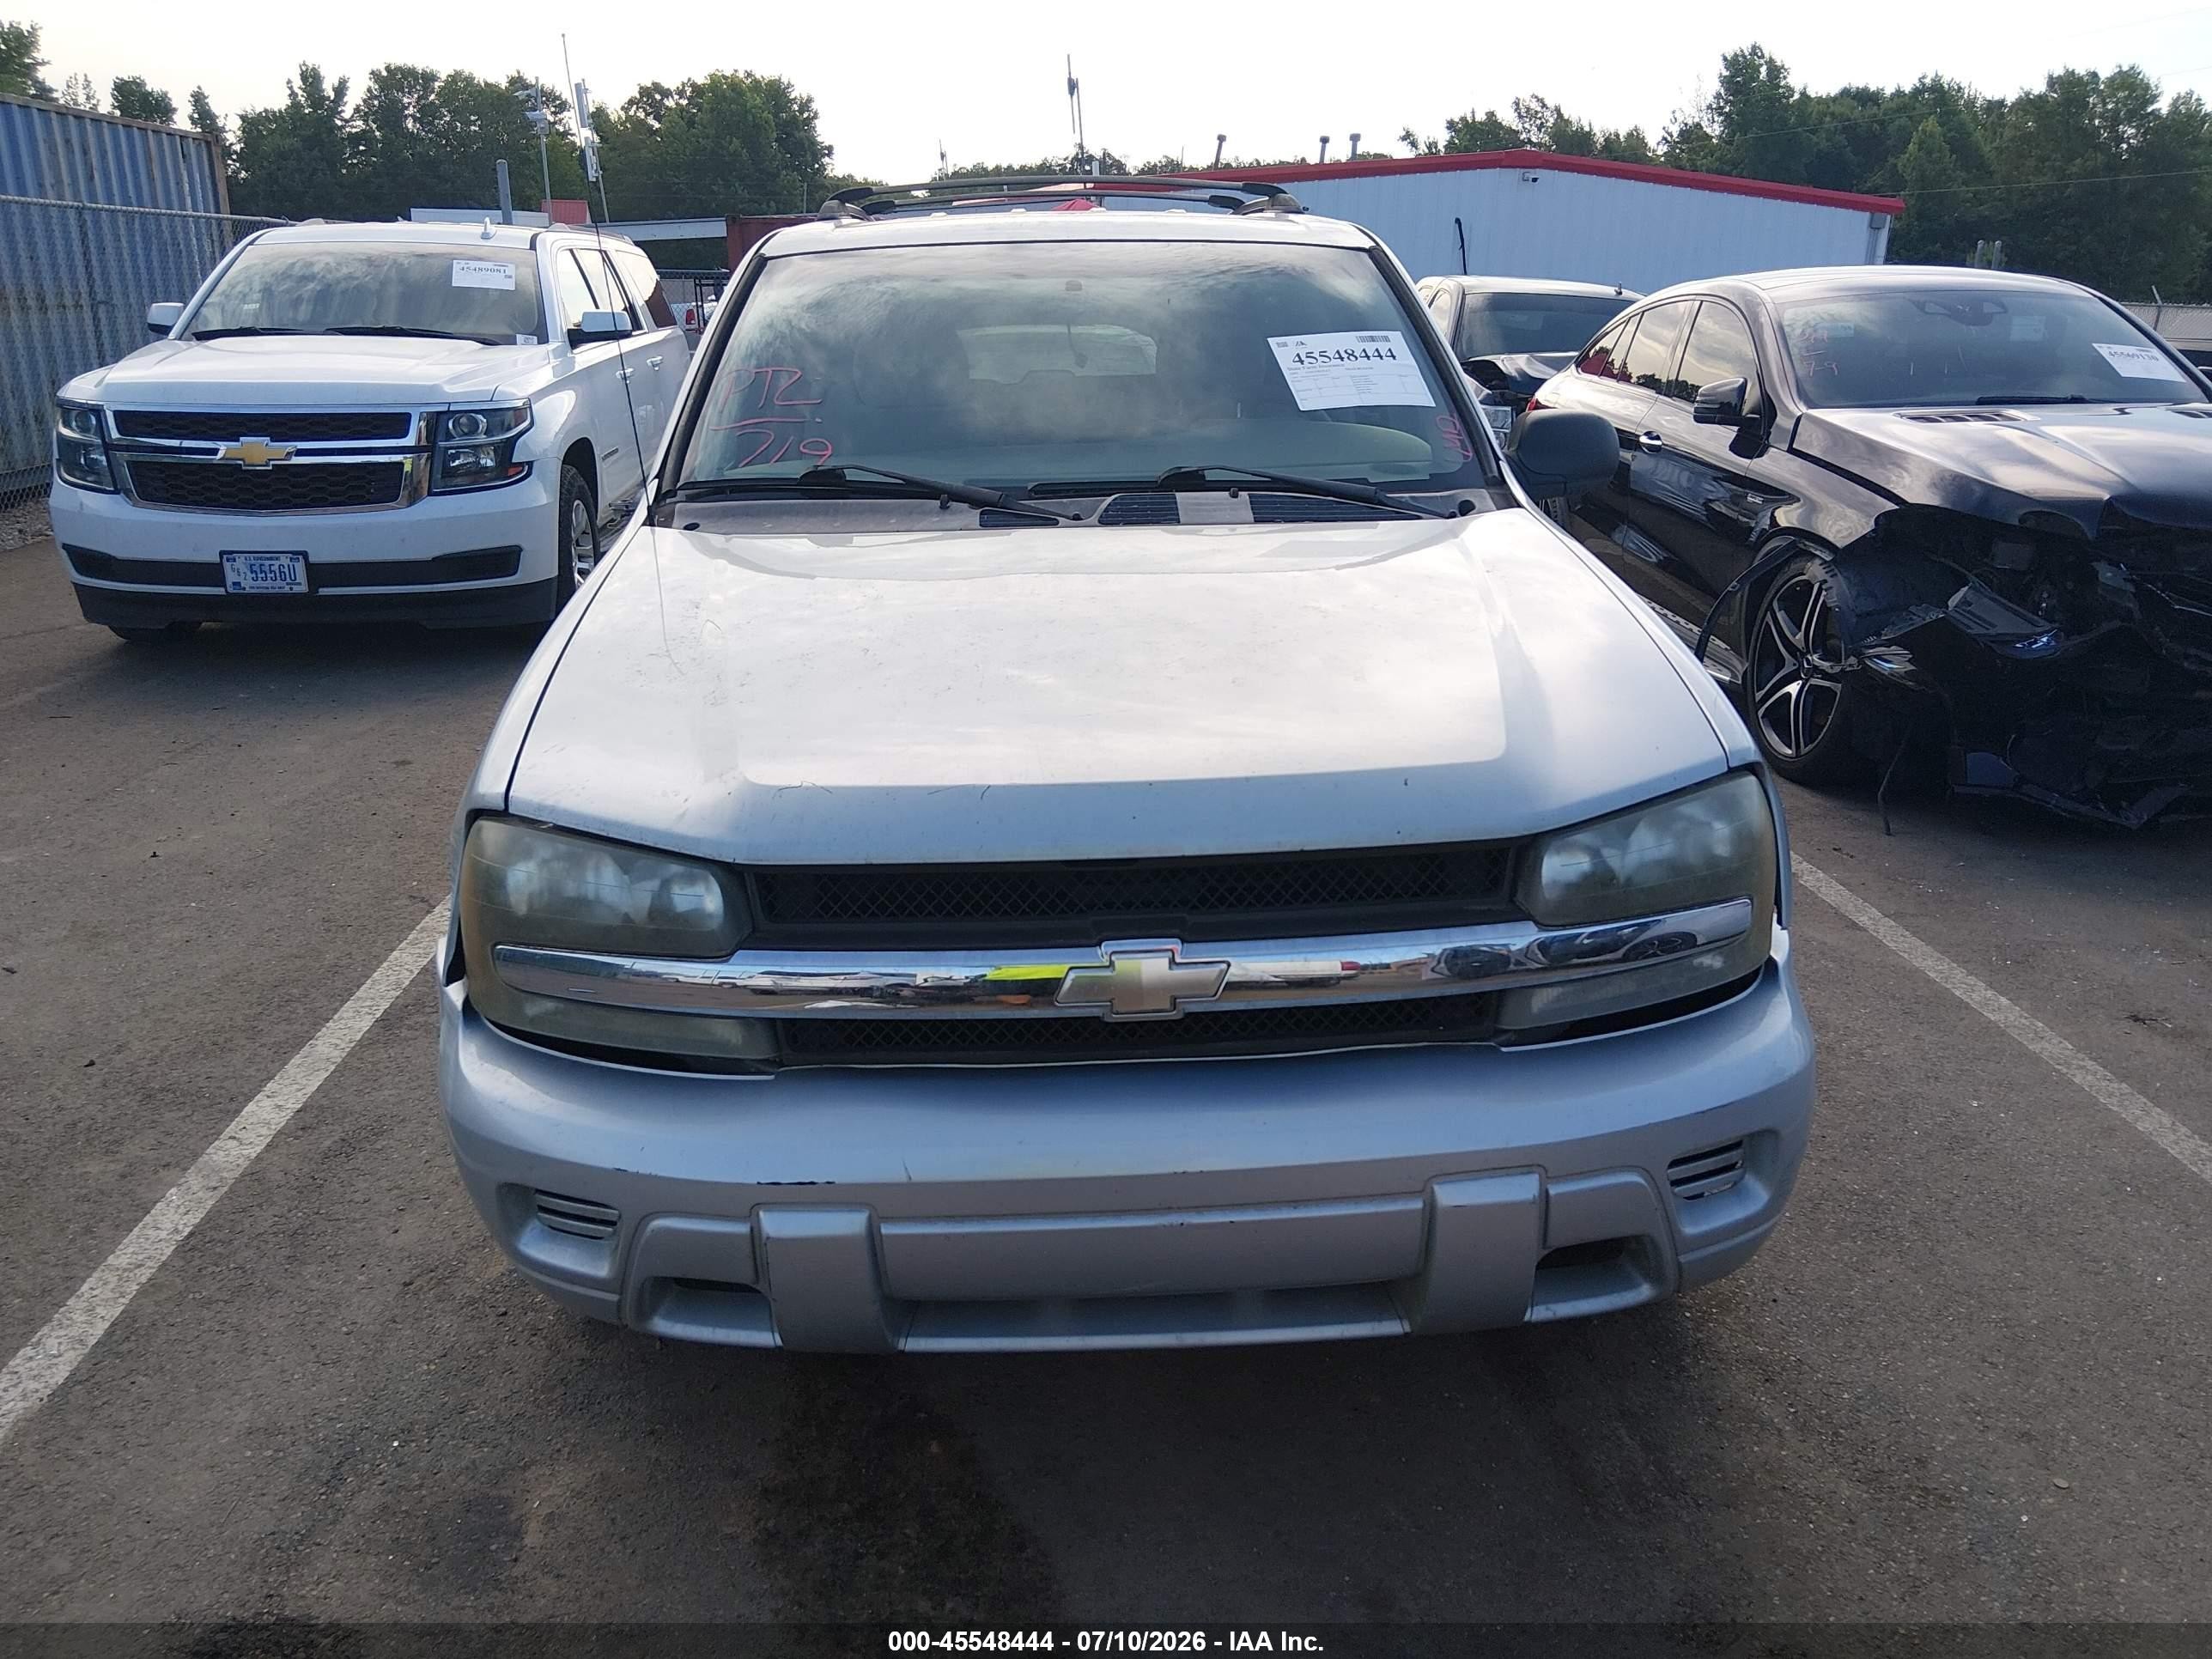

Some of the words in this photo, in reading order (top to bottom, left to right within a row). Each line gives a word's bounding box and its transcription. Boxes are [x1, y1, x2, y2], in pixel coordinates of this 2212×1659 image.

[459, 265, 507, 274] 45489081
[1291, 348, 1397, 365] 45548444
[249, 563, 297, 582] 5556U
